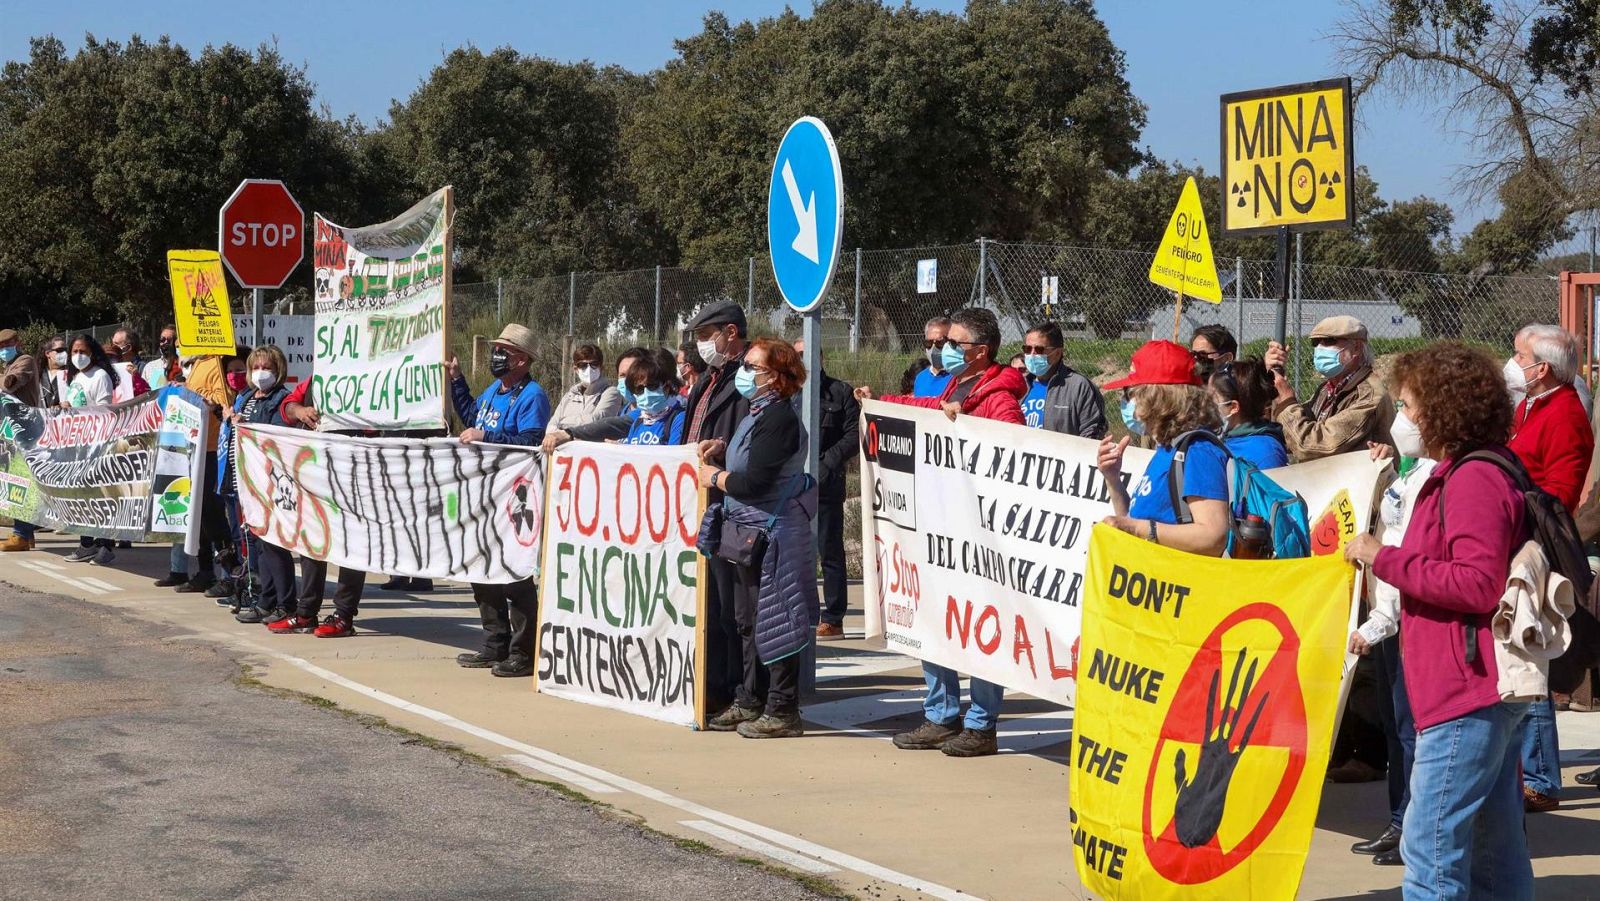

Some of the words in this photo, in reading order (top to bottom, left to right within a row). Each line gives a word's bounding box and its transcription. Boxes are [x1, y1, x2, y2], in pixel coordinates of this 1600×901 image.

[1235, 95, 1337, 161] MINA
[1254, 158, 1316, 219] NO
[231, 222, 296, 247] STOP
[315, 243, 346, 266] MINA
[1172, 245, 1203, 263] PELIGRO
[287, 336, 304, 346] DE
[288, 353, 314, 363] INO
[340, 324, 359, 359] AL
[367, 313, 408, 361] TREN
[312, 373, 368, 417] DESDE
[369, 366, 390, 412] LA
[1021, 399, 1045, 414] STO
[878, 433, 887, 451] AL
[887, 434, 913, 457] URANIO
[924, 432, 956, 469] POR
[958, 438, 982, 475] LA
[90, 497, 117, 528] SER
[236, 427, 332, 559] SOS
[892, 491, 907, 511] VIDA
[977, 495, 997, 532] LA
[1002, 502, 1081, 550] SALUD
[556, 542, 697, 628] ENCINAS
[890, 542, 920, 612] Stop
[927, 532, 956, 570] DEL
[962, 540, 1006, 587] CAMPO
[1008, 555, 1083, 607] CHARR
[1108, 564, 1190, 618] DON'T
[945, 595, 1001, 655] NO
[1013, 614, 1037, 680] A
[1087, 648, 1164, 704] NUKE
[1078, 735, 1128, 785] THE
